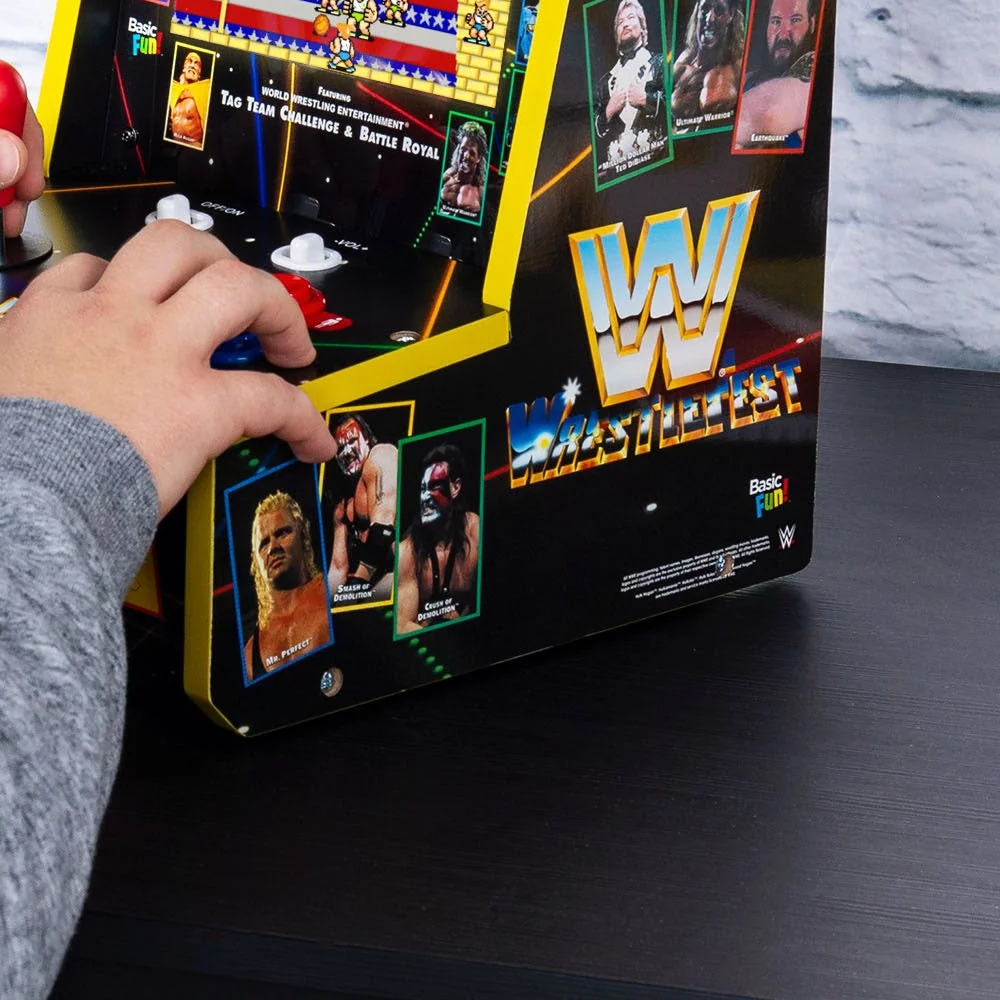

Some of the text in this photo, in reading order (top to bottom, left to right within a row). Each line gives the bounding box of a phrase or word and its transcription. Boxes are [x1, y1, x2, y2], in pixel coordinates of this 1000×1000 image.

[128, 16, 158, 38] Basic
[132, 31, 163, 57] Fun!
[261, 86, 289, 102] WORLD
[290, 93, 336, 114] WRESTLING
[317, 85, 351, 103] FEATURING
[220, 89, 440, 161] TAG TEAM CHALLENGE & BATTLE ROYAL
[506, 356, 803, 489] WRESTLEFEST
[749, 472, 783, 496] Basic
[755, 478, 789, 519] Fun!
[333, 591, 372, 602] DEMOLITION
[337, 584, 361, 594] SMASH
[417, 605, 456, 621] DEMOLITION
[424, 600, 444, 611] CRUSH
[281, 638, 310, 659] PERFECT
